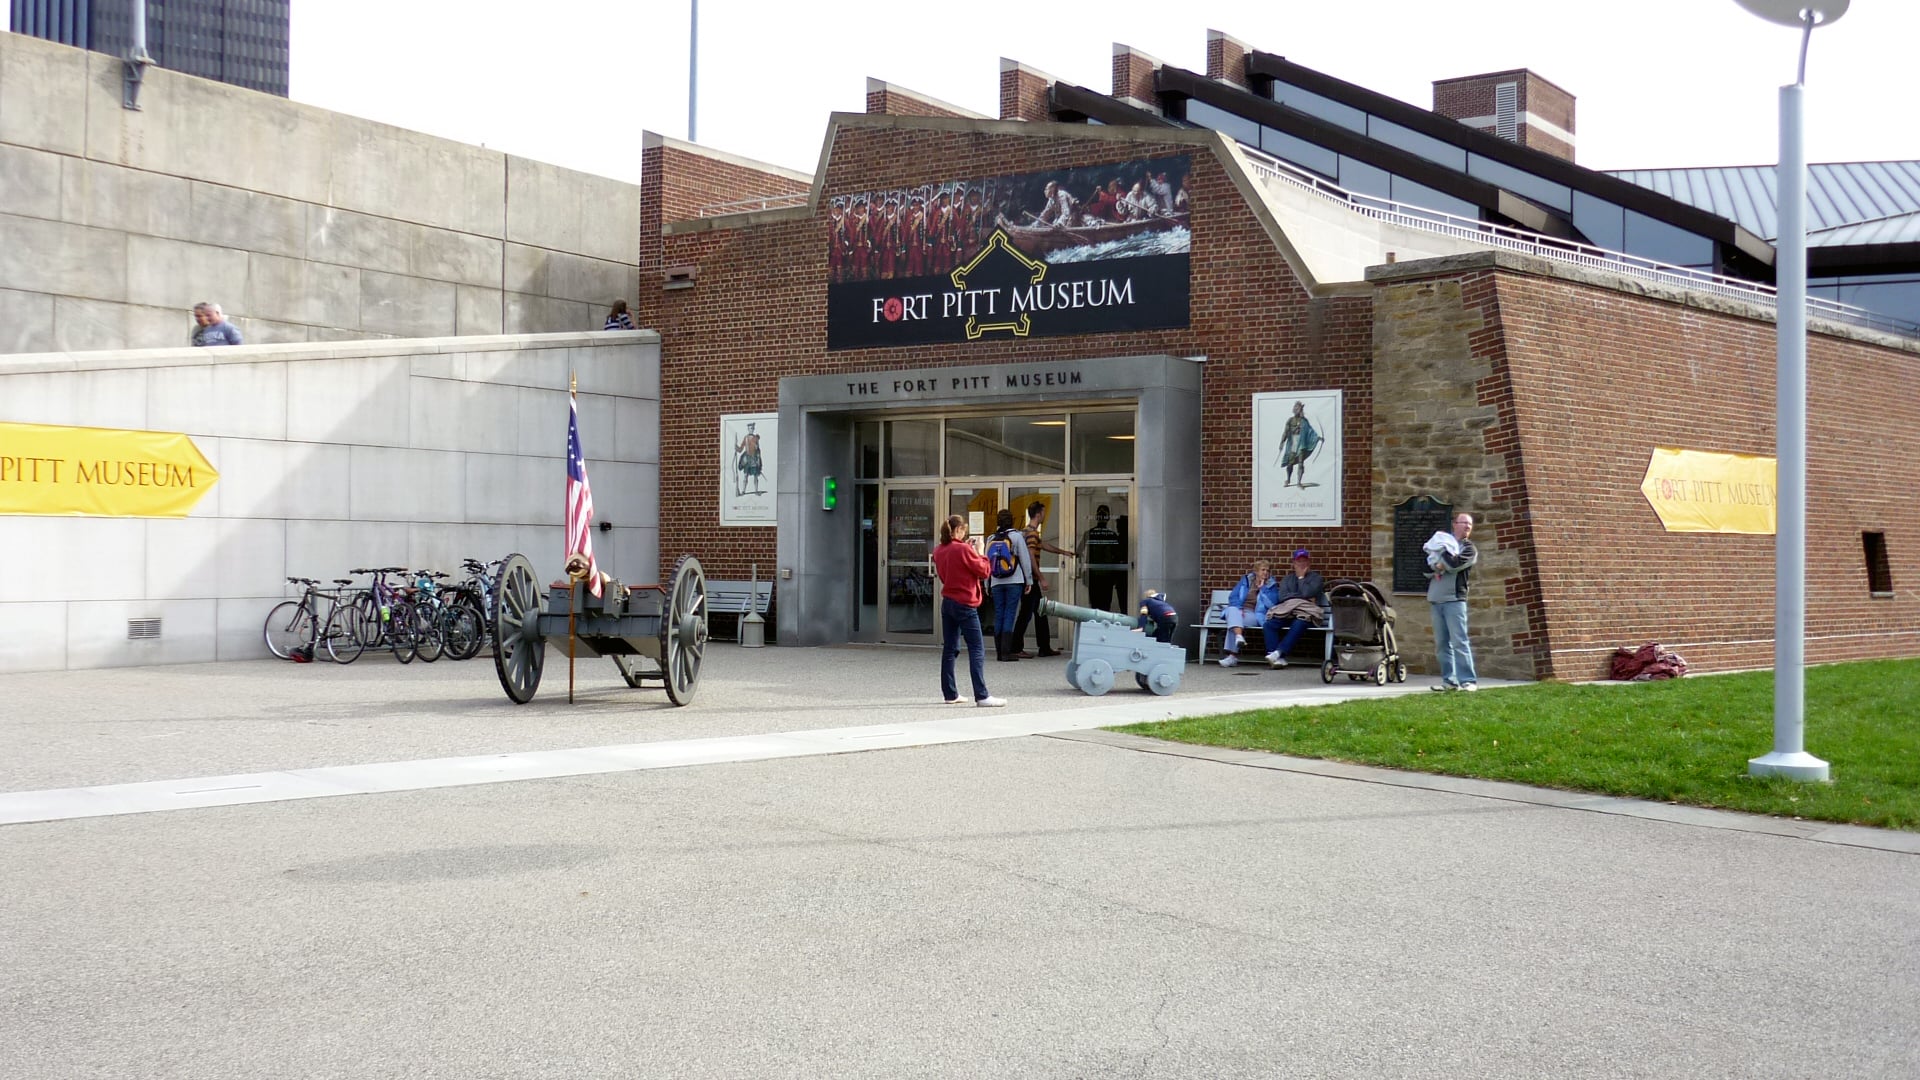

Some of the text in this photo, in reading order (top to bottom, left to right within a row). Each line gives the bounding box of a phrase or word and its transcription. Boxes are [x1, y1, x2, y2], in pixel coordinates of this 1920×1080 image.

[872, 278, 1136, 323] FORT PITT MUSEUM
[847, 371, 1082, 395] THE FORT PITT MUSEUM
[0, 456, 196, 488] PITT MUSEUM
[1654, 477, 1687, 502] FORT
[1692, 480, 1721, 503] PITT
